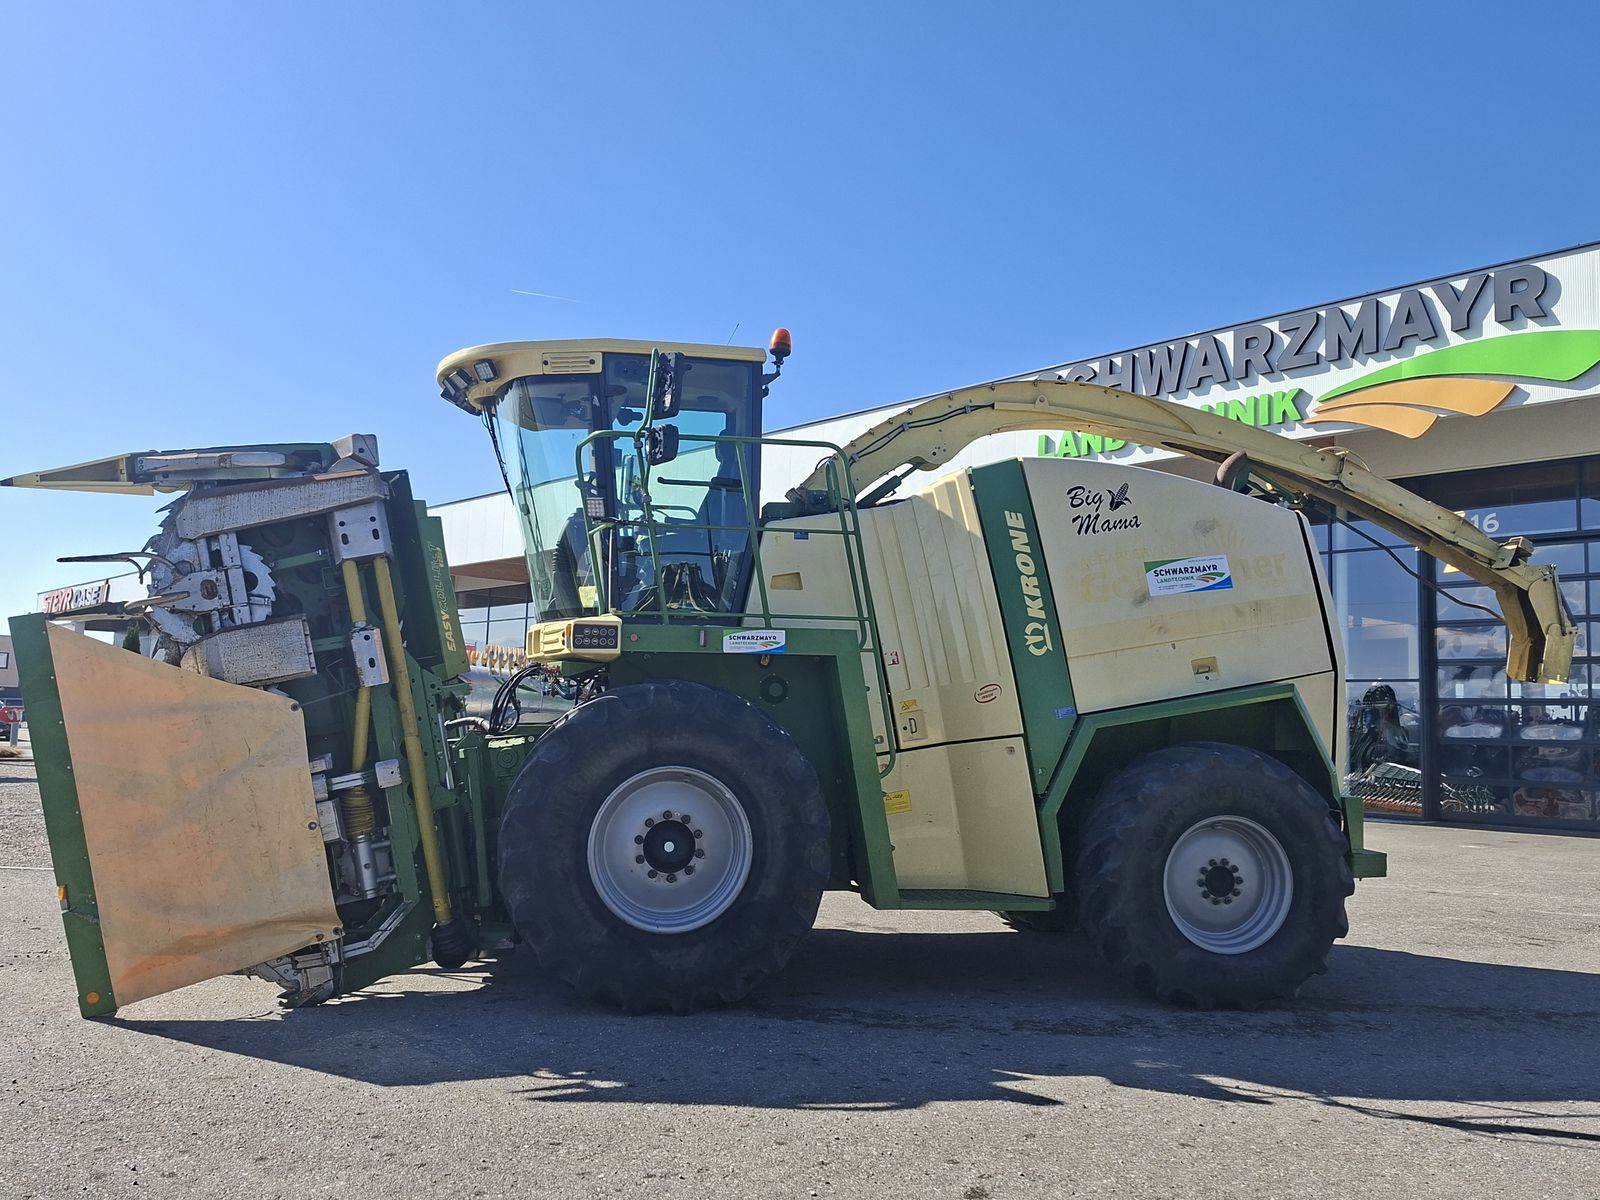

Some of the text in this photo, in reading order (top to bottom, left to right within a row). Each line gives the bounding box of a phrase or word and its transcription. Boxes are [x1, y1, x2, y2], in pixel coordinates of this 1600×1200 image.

[1037, 265, 1547, 396] HWARZMAYR
[1038, 388, 1302, 457] LANDNIK
[1066, 485, 1105, 513] Big
[1071, 513, 1142, 536] Mama
[1470, 512, 1500, 533] 16
[1004, 510, 1047, 620] KRONE
[1153, 564, 1218, 577] SCHWARZMAYR
[1156, 576, 1195, 584] LANDTECHNIK
[43, 587, 73, 613] STEYR
[72, 586, 101, 608] CASE
